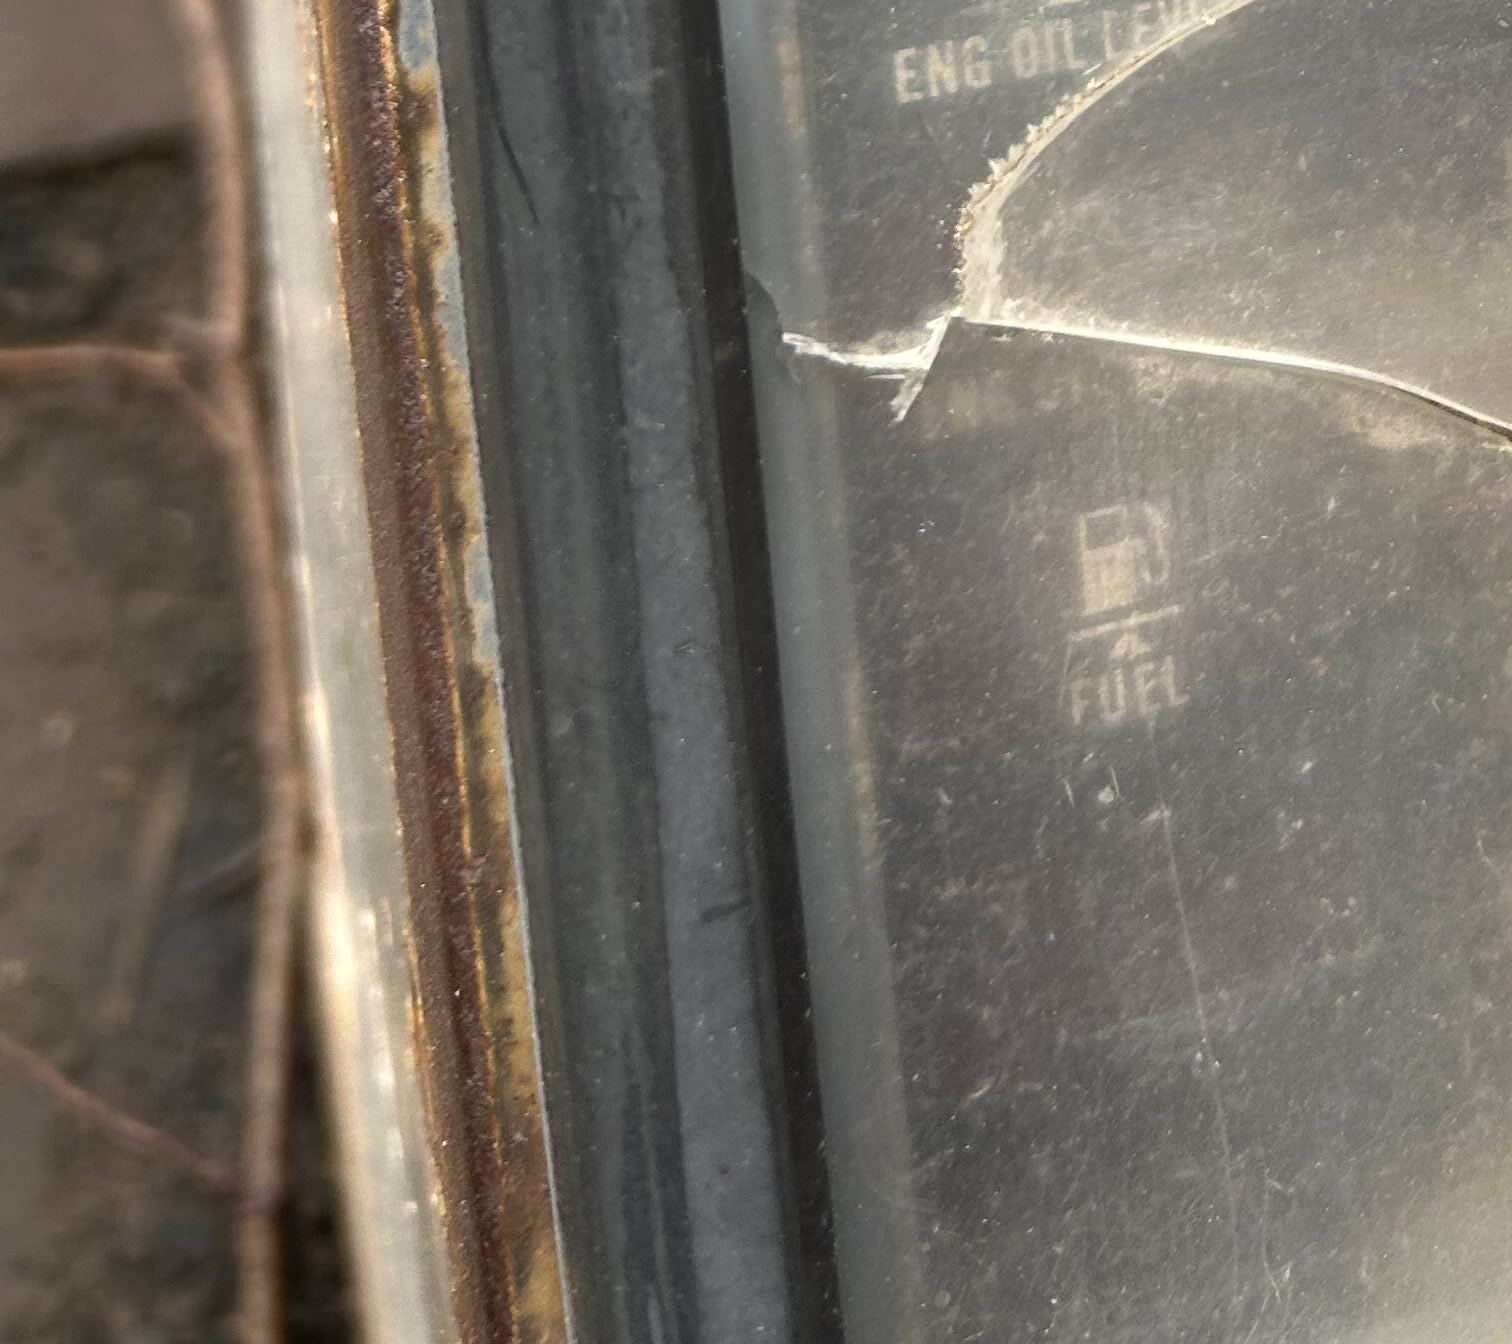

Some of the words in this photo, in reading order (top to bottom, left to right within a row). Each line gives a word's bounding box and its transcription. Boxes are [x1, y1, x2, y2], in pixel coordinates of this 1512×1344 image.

[895, 34, 992, 104] ENG
[1011, 18, 1089, 81] OIL
[1070, 654, 1190, 727] FUEL
